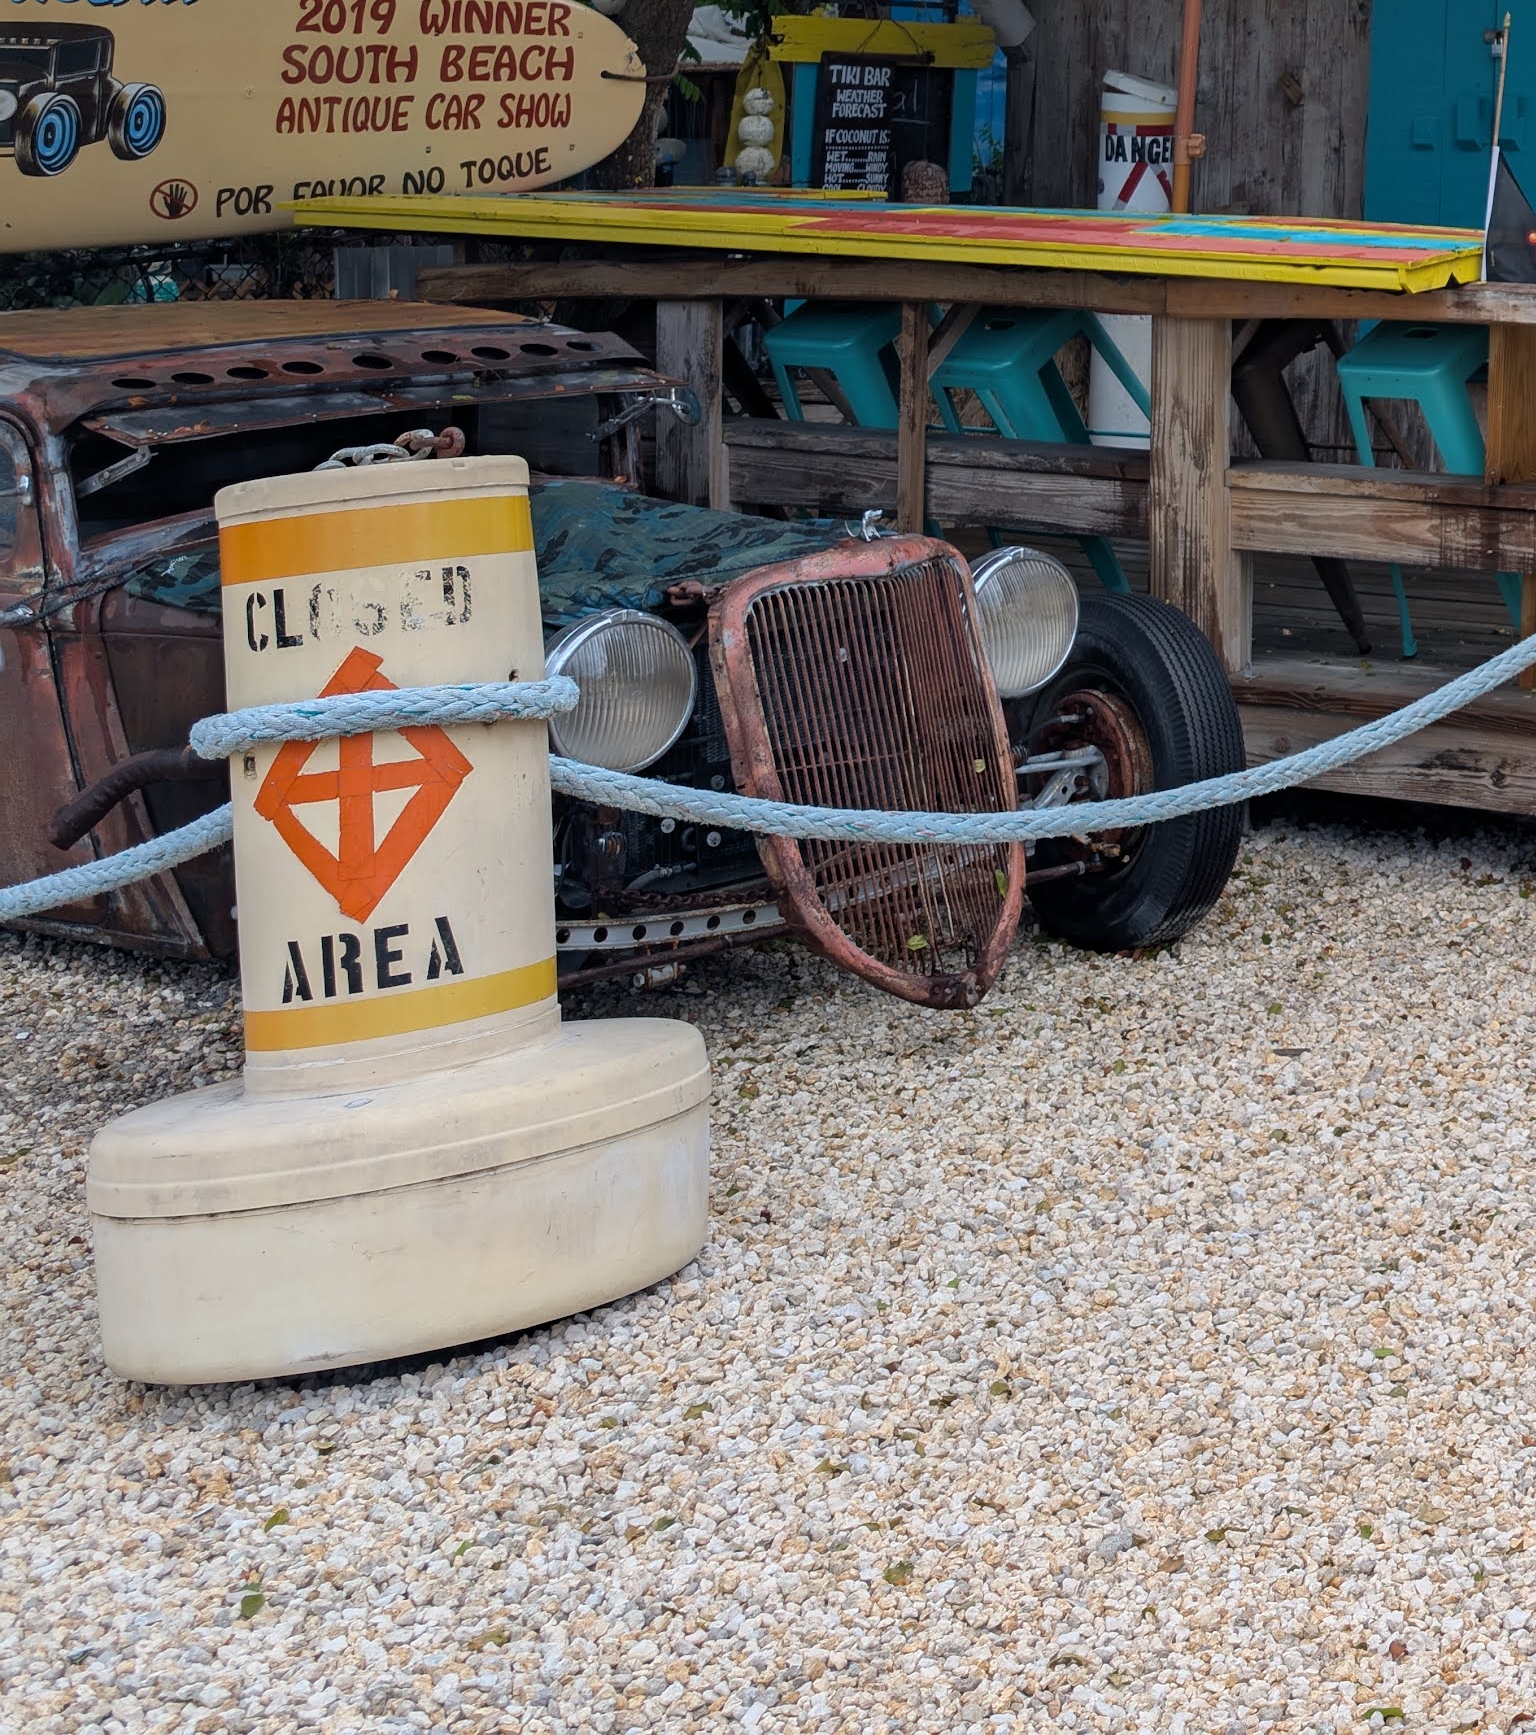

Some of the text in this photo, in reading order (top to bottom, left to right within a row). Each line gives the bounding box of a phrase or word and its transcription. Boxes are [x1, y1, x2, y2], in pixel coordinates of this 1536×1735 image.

[419, 0, 570, 37] WINNER
[280, 43, 575, 84] SOUTH BEACH
[829, 65, 891, 87] TIKI BAR
[275, 93, 572, 135] ANTIQUE CAR SHOW
[832, 103, 887, 118] FORECAST
[837, 89, 883, 103] WEATHER
[825, 129, 834, 143] IF
[836, 129, 878, 143] COCONUT
[216, 185, 274, 217] POR
[402, 166, 445, 195] NO
[460, 147, 552, 188] TOQUE
[282, 916, 464, 1004] AREA
